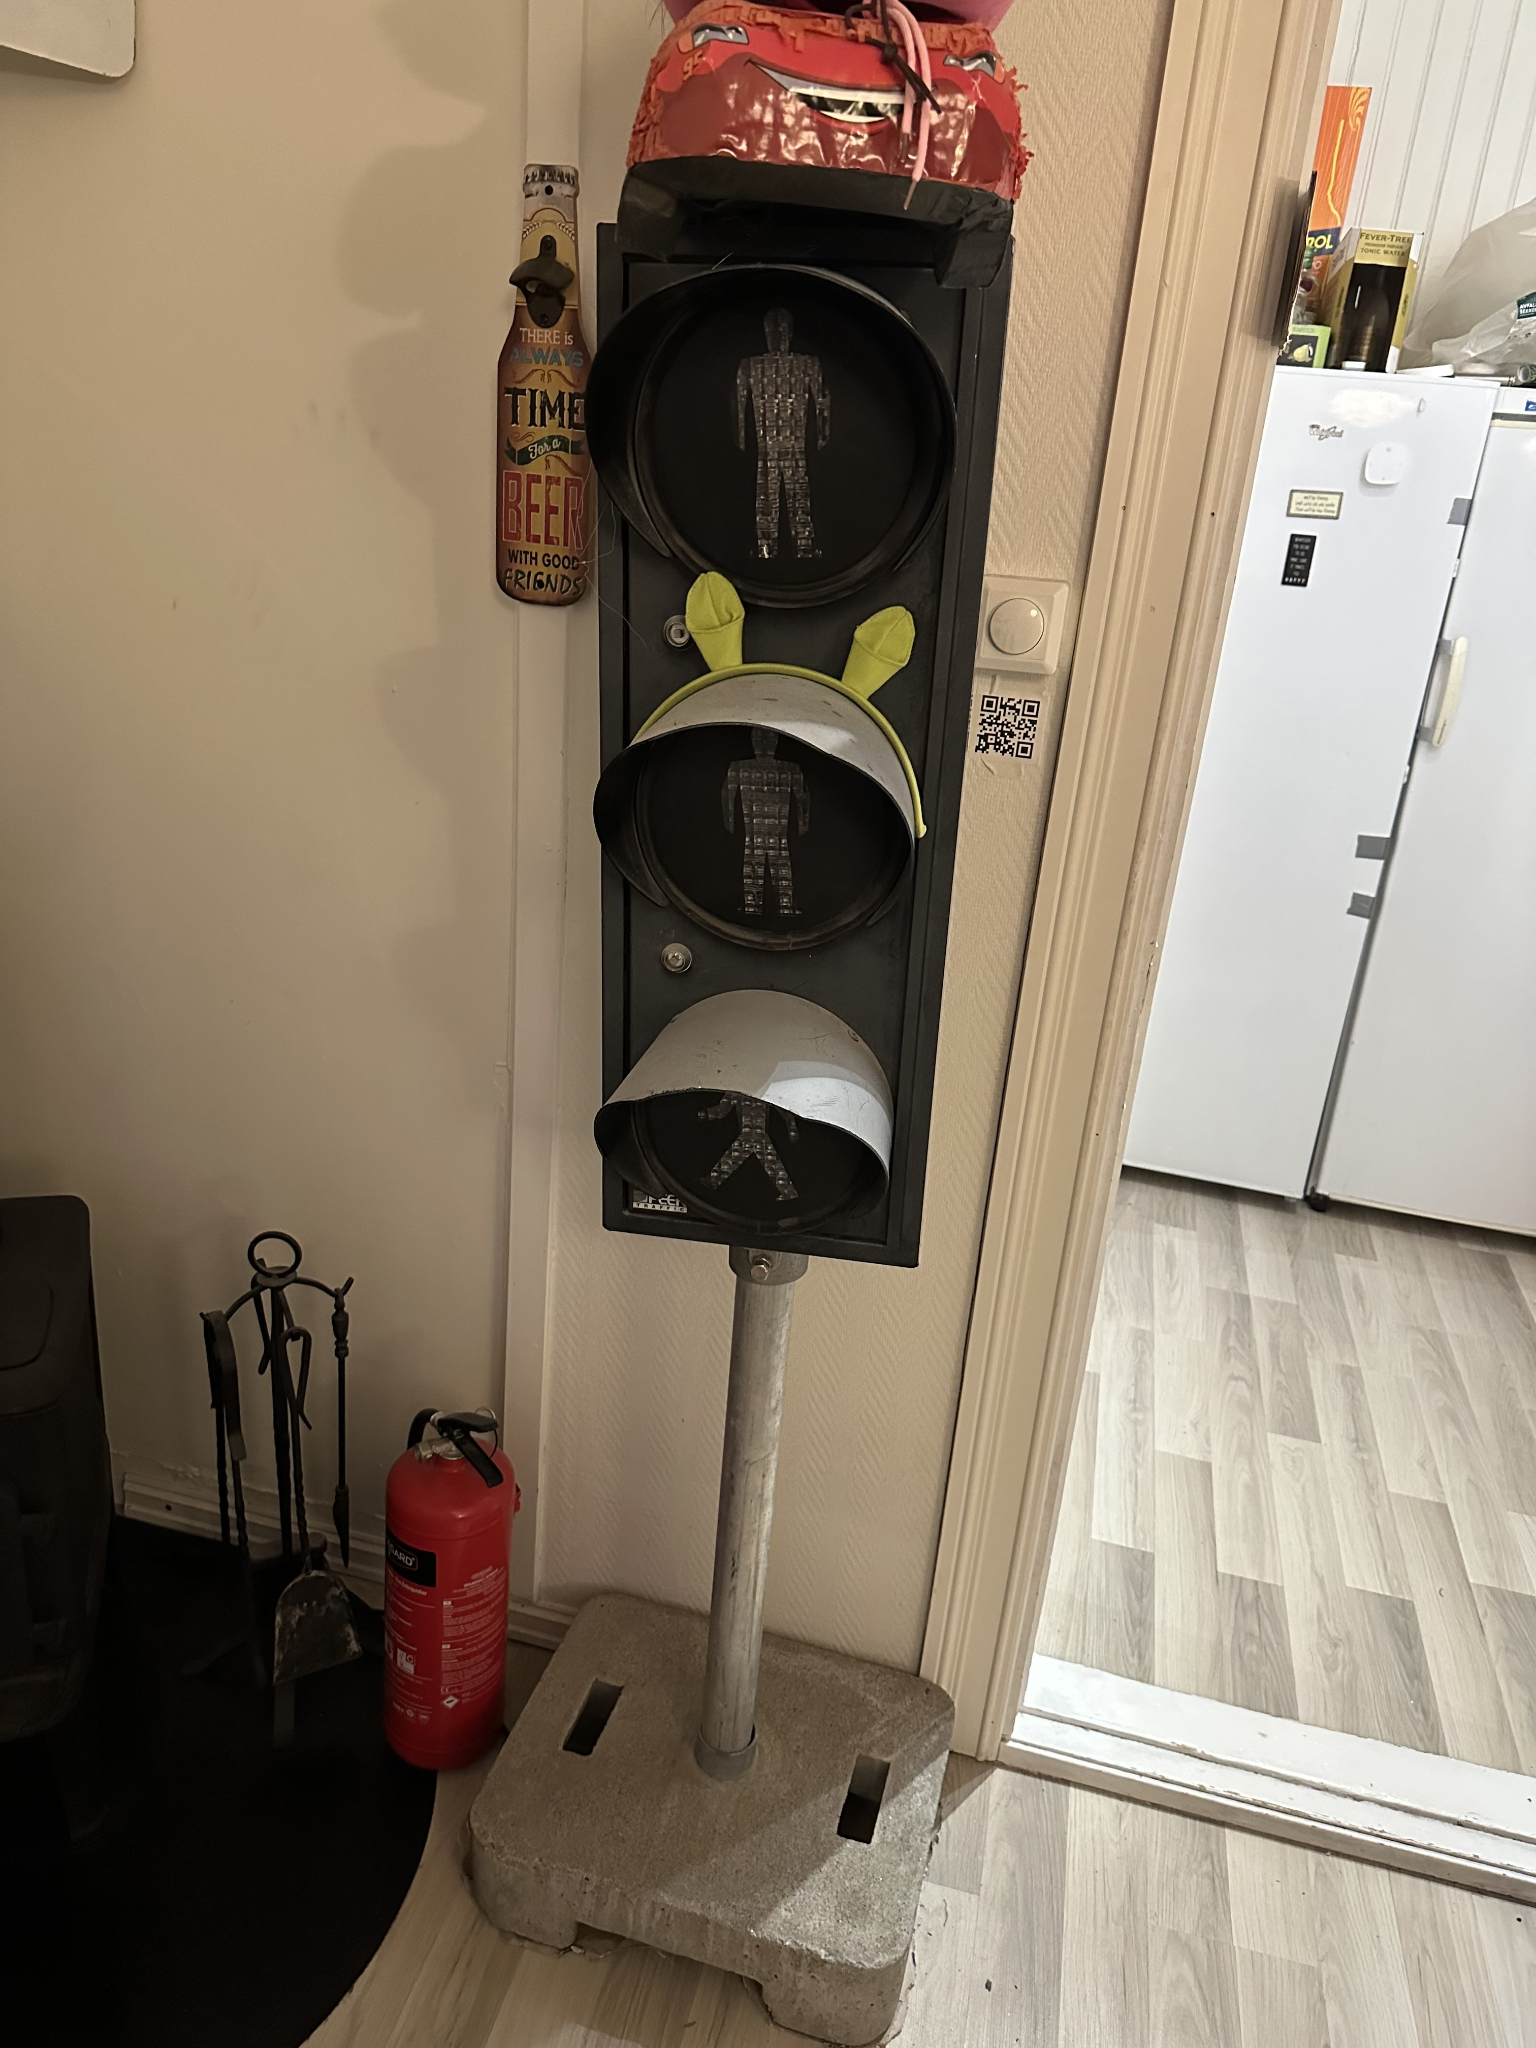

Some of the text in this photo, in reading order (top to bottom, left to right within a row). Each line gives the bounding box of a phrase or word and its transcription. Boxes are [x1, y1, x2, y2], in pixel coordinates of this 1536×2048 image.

[1359, 232, 1413, 243] FEVER-TREE
[1383, 249, 1406, 257] WATER
[519, 327, 574, 345] THERE is
[509, 346, 584, 367] ALWAYS
[503, 387, 586, 432] TIME
[527, 438, 562, 460] For a
[502, 470, 584, 550] BEER
[508, 548, 581, 571] WITH GOOD
[504, 567, 584, 596] FRIENDS
[636, 1202, 685, 1211] TRAFFIC
